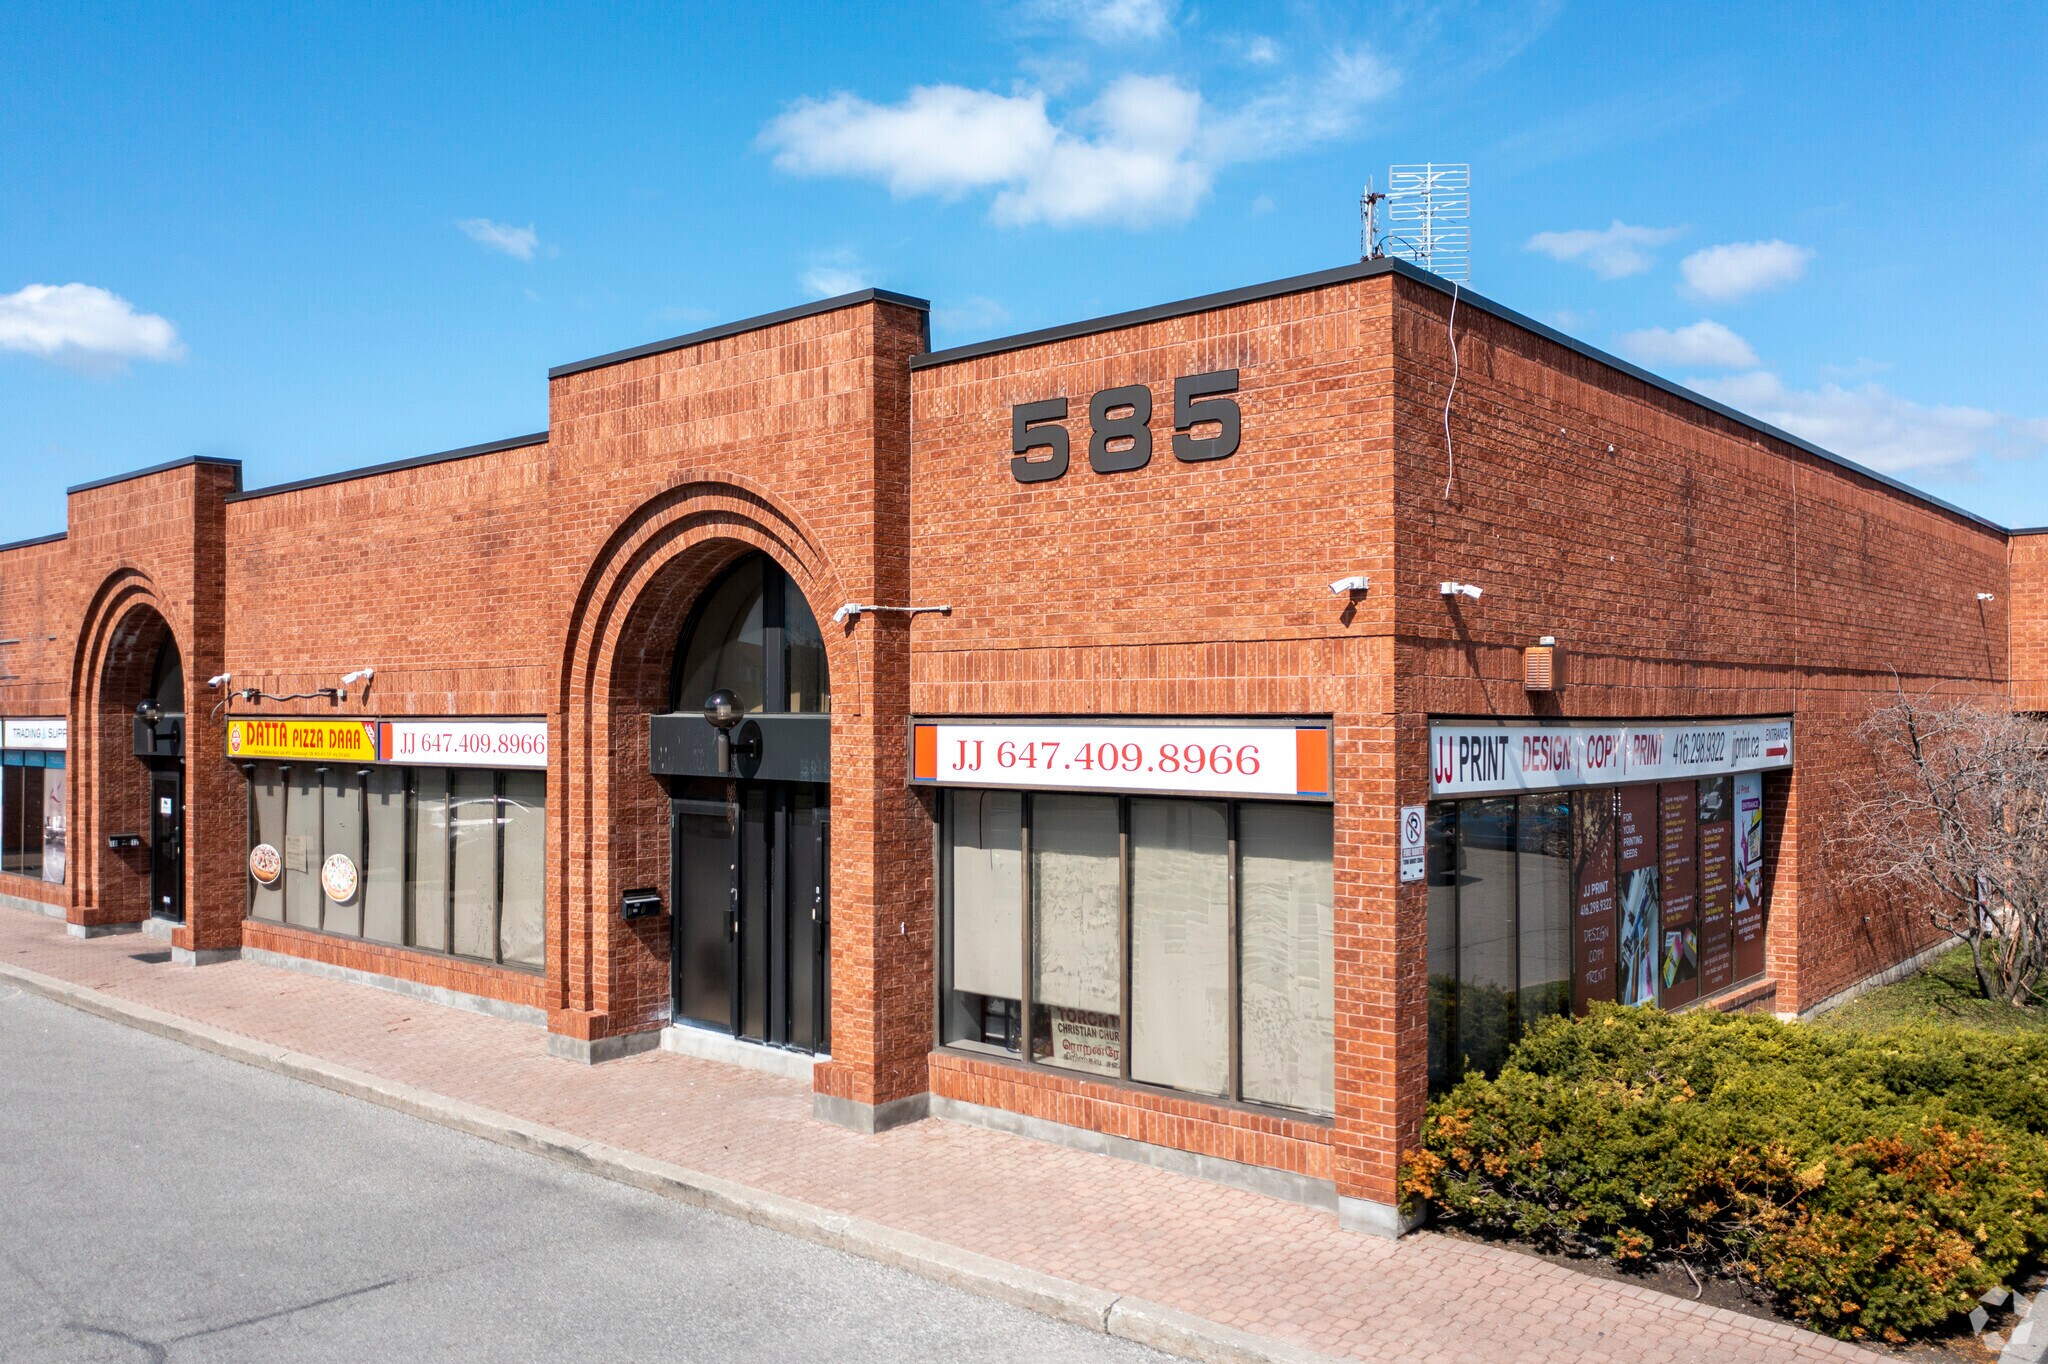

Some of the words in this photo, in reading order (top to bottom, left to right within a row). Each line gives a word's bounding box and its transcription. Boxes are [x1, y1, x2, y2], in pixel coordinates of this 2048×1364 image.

[1011, 368, 1241, 483] 585
[12, 727, 41, 738] TRADING
[247, 721, 287, 747] DATTA
[293, 728, 323, 748] PIZZA
[1765, 727, 1789, 741] ENTRANCE
[400, 733, 415, 754] JJ
[421, 733, 545, 754] 647.409.8966
[952, 740, 984, 771] JJ
[996, 740, 1260, 776] 647.409.8966
[1434, 736, 1454, 784] JJ
[1459, 736, 1509, 782] PRINT
[1522, 735, 1571, 772] DESIGN
[1587, 734, 1620, 769] COPY
[1632, 733, 1664, 767] PRINT
[1673, 731, 1725, 765] 416.298.9322
[1742, 800, 1759, 810] ENTRANCE
[1623, 813, 1632, 822] FOR
[1623, 825, 1636, 834] YOUR
[1623, 835, 1643, 846] PRINTING
[1623, 848, 1638, 859] NEEDS
[1583, 885, 1591, 898] JJ
[1591, 880, 1609, 895] PRINT
[1580, 898, 1613, 916] 416.298.9322
[1583, 925, 1609, 943] DESIGN
[1588, 947, 1605, 963] COPY
[1586, 968, 1608, 984] PRINT
[1058, 1022, 1097, 1038] CHRISTIAN
